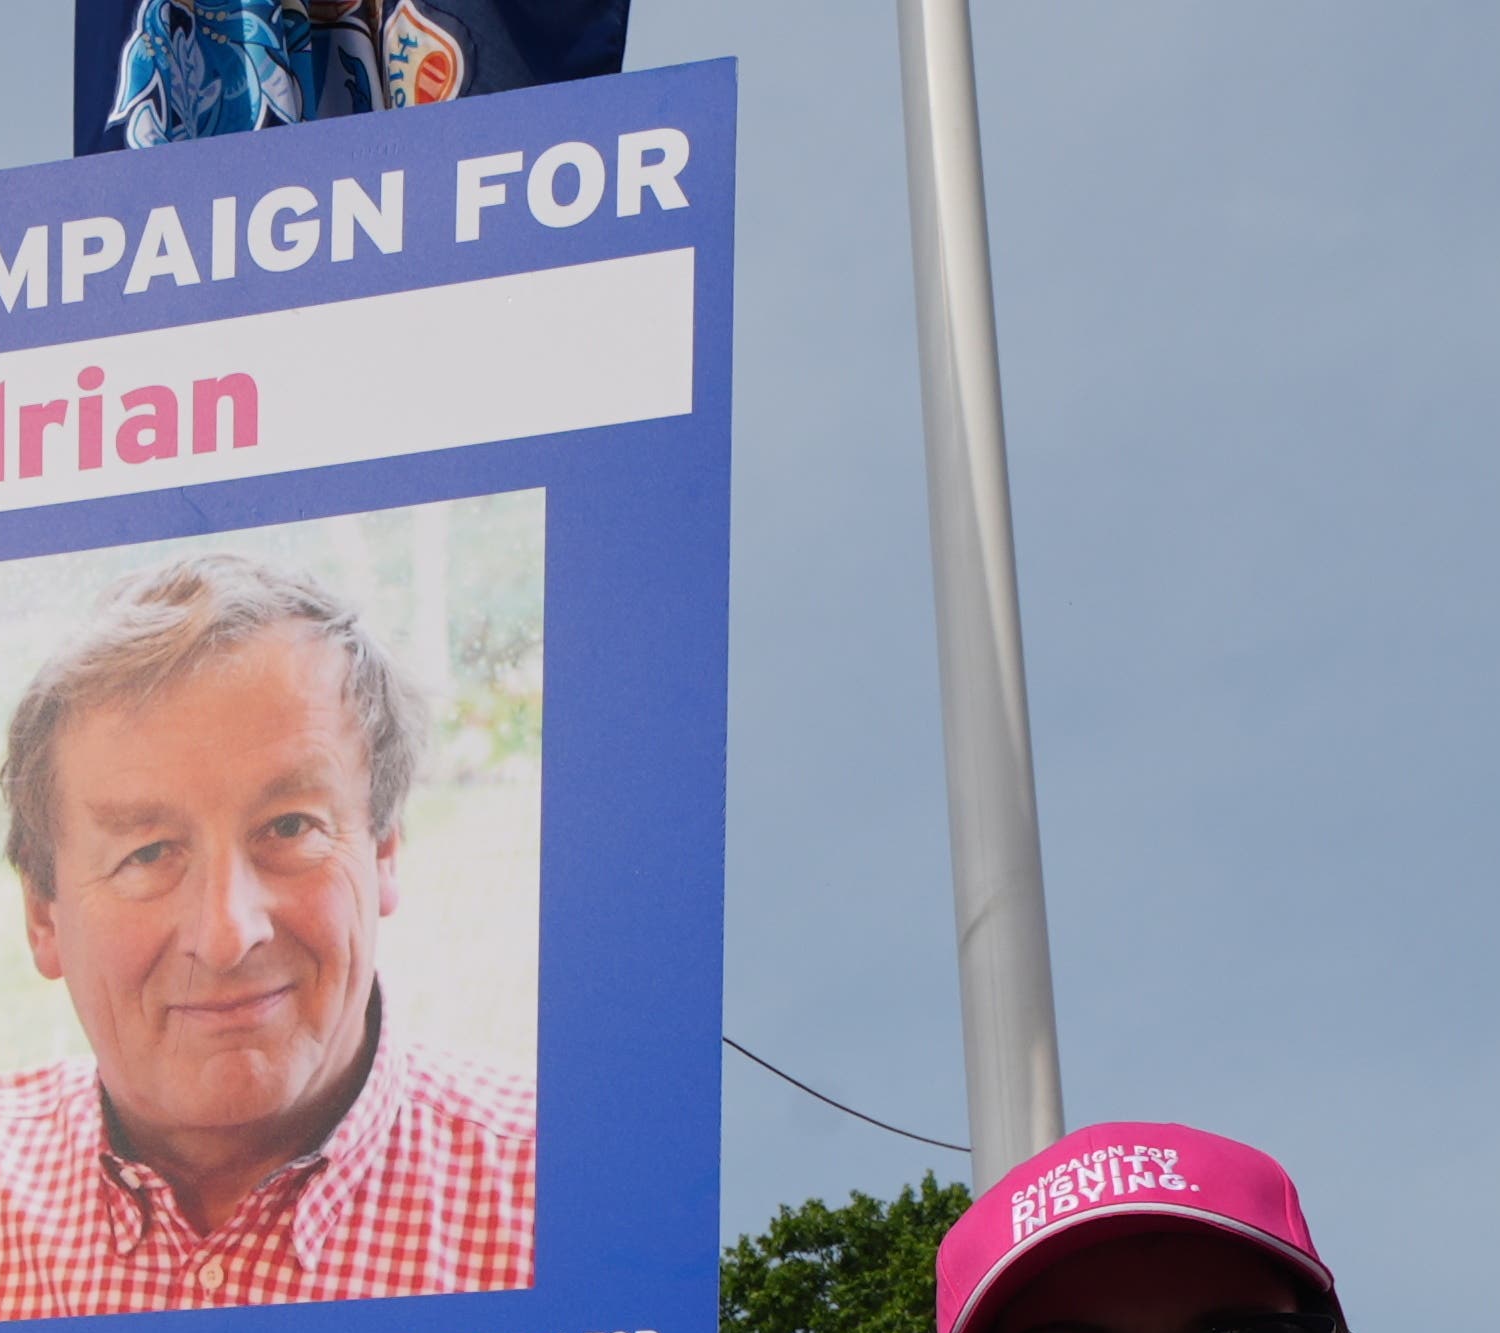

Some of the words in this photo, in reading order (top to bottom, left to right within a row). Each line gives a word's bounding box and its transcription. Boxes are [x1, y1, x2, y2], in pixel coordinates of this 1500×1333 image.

[456, 128, 689, 242] FOR
[1011, 1145, 1124, 1204] CAMPAIGN
[1133, 1145, 1178, 1160] FOR
[1012, 1155, 1179, 1224] DIGNITY
[1013, 1207, 1047, 1244] IN
[1053, 1172, 1200, 1217] DYING.
